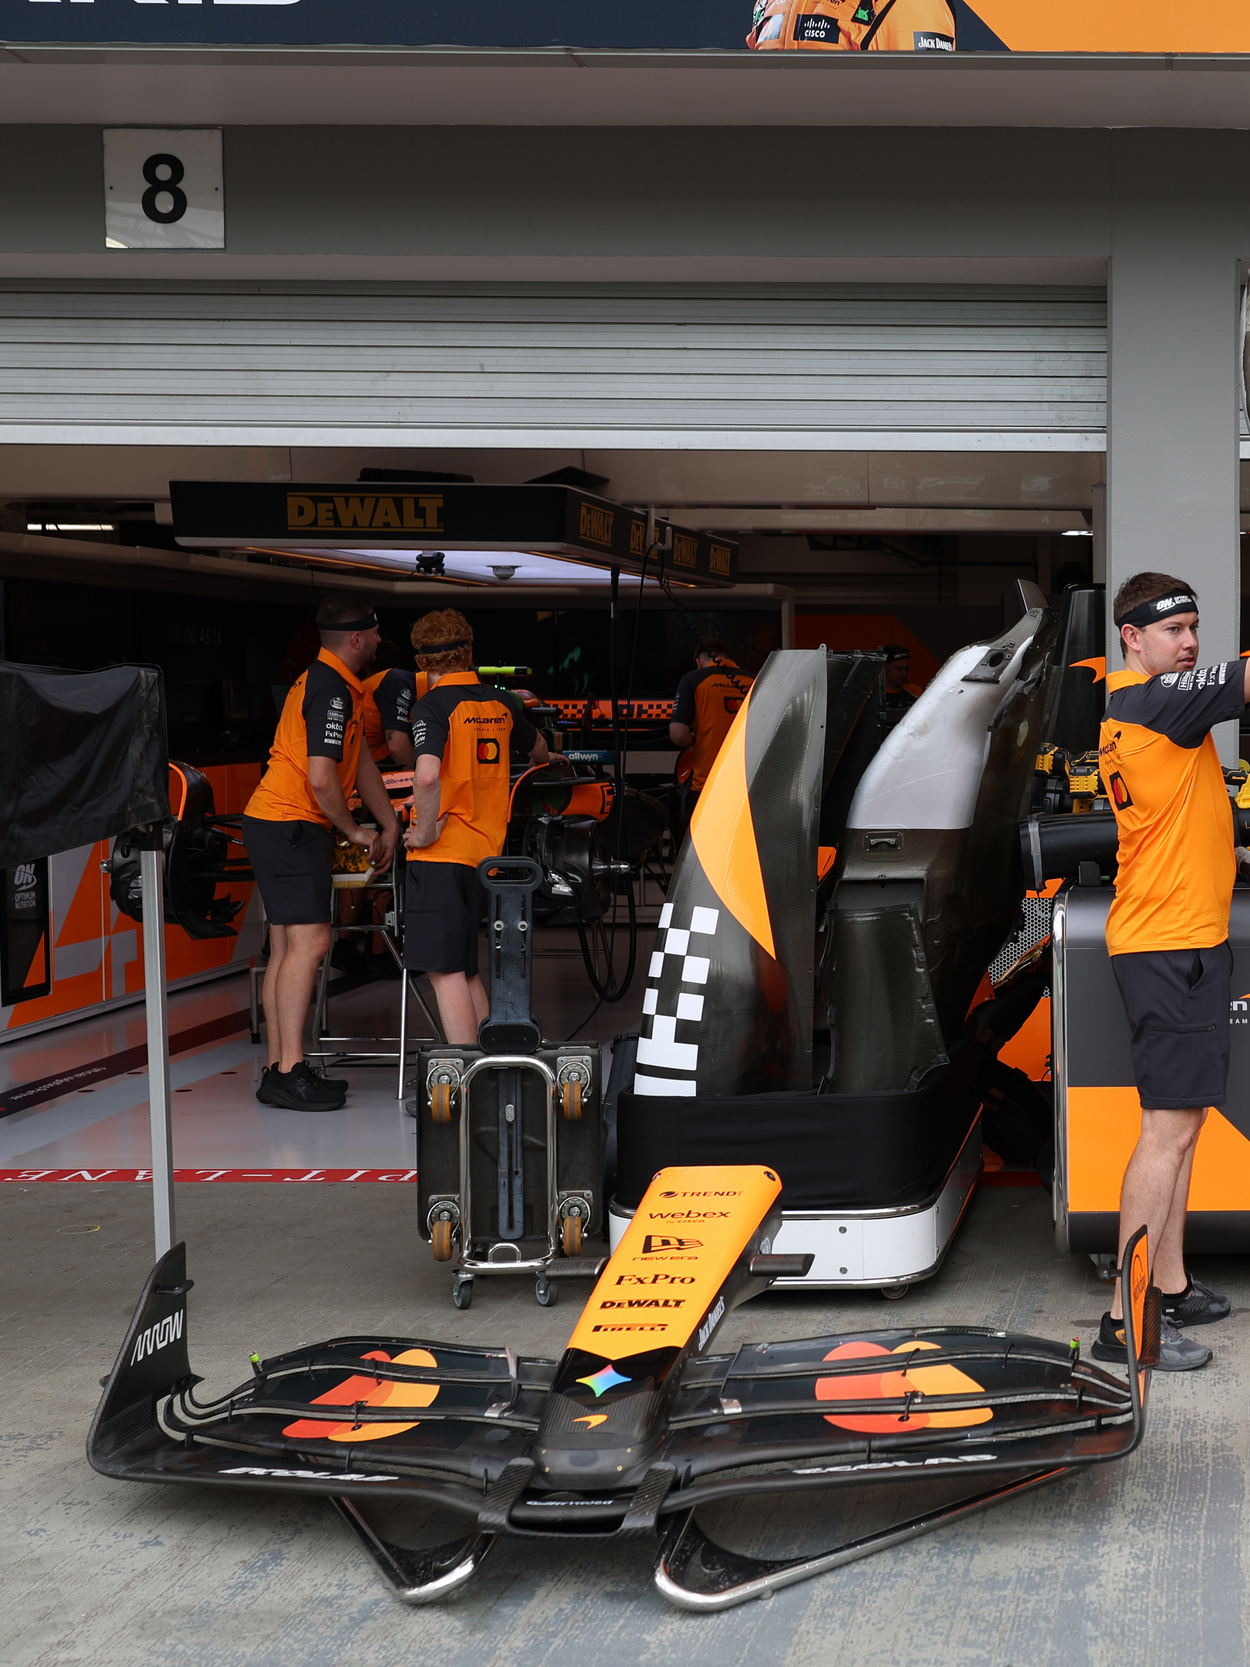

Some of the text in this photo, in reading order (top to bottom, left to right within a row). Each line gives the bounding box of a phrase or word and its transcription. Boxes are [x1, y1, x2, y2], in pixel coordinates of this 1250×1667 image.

[918, 37, 935, 49] JACK
[141, 153, 187, 224] 8
[325, 722, 343, 731] okta
[568, 751, 599, 761] allwyn
[14, 863, 36, 886] ON
[649, 1210, 733, 1219] webex
[614, 1273, 696, 1286] FxPro
[600, 1299, 686, 1310] DEWALT
[591, 1323, 669, 1333] PIRELLI
